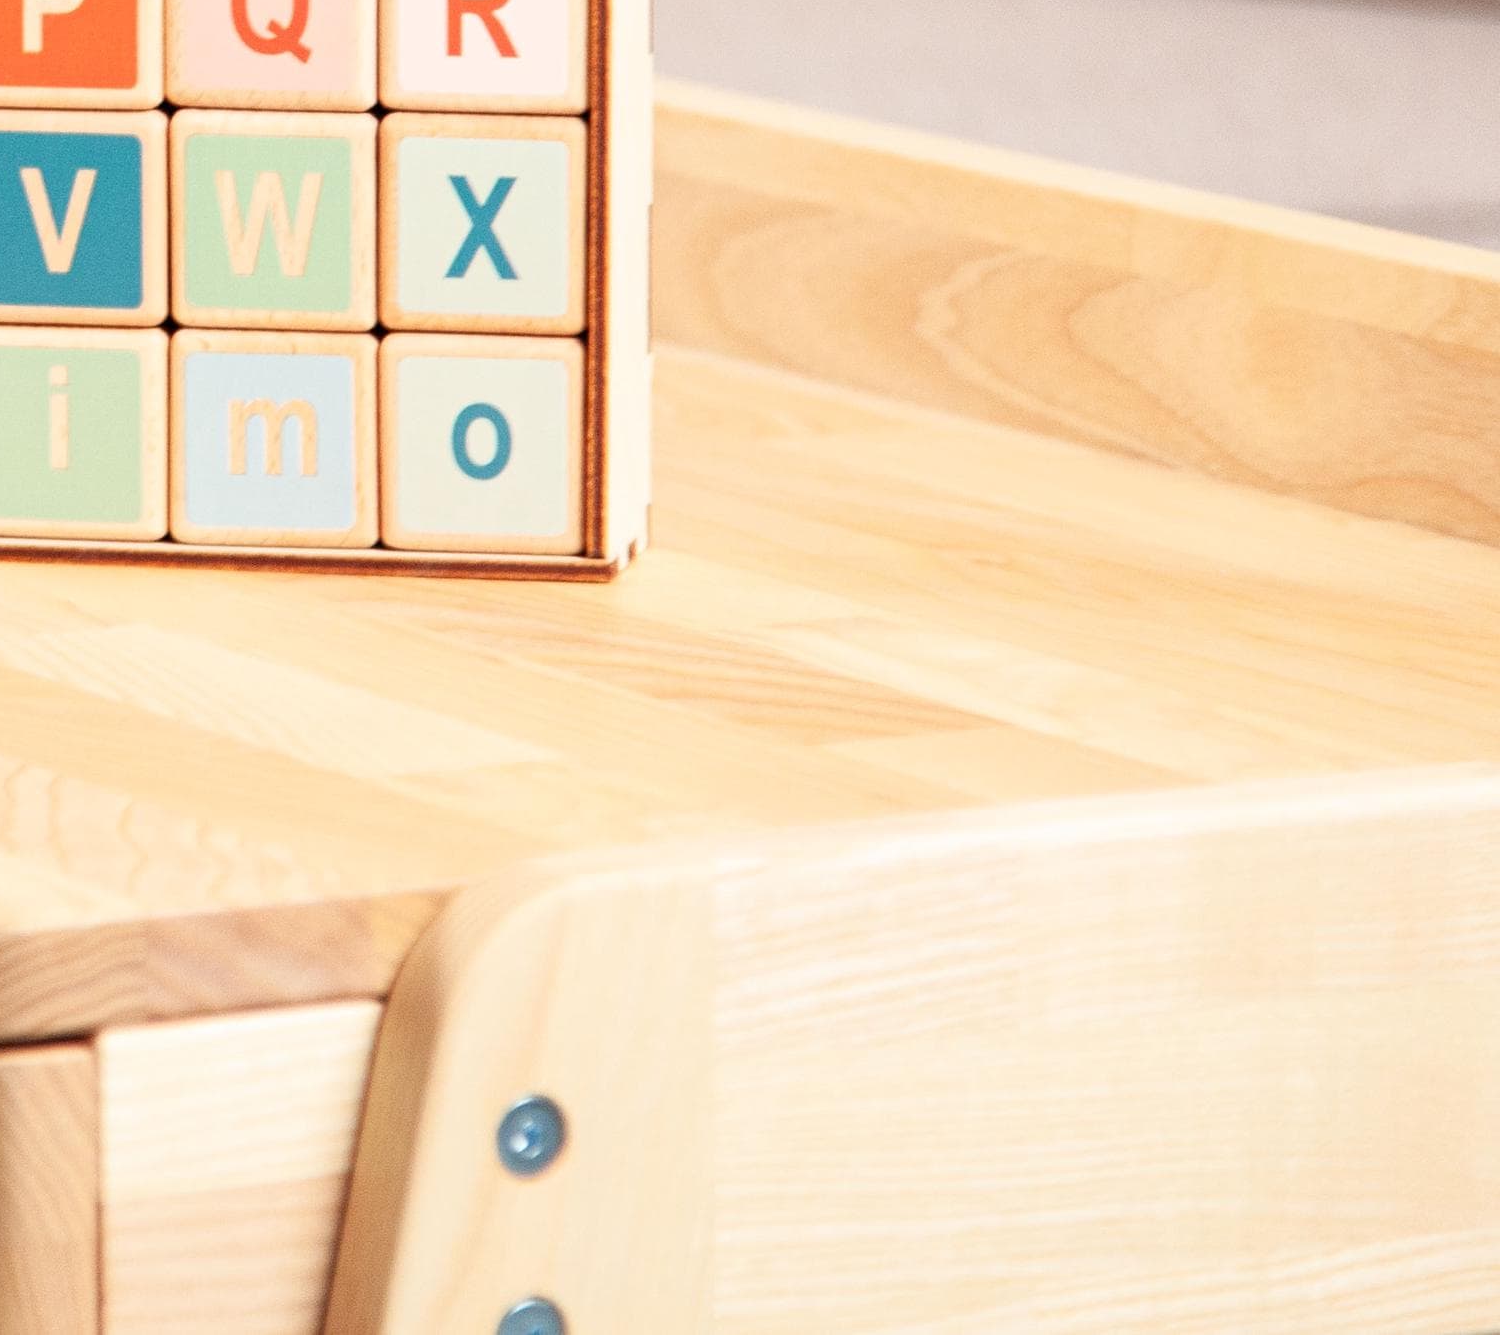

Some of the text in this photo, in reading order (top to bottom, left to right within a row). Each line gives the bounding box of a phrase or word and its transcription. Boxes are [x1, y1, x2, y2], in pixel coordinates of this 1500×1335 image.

[20, 167, 97, 274] V
[214, 169, 325, 279] W
[445, 175, 518, 280] X
[48, 364, 71, 472] i
[228, 398, 318, 476] m
[451, 402, 512, 481] o
